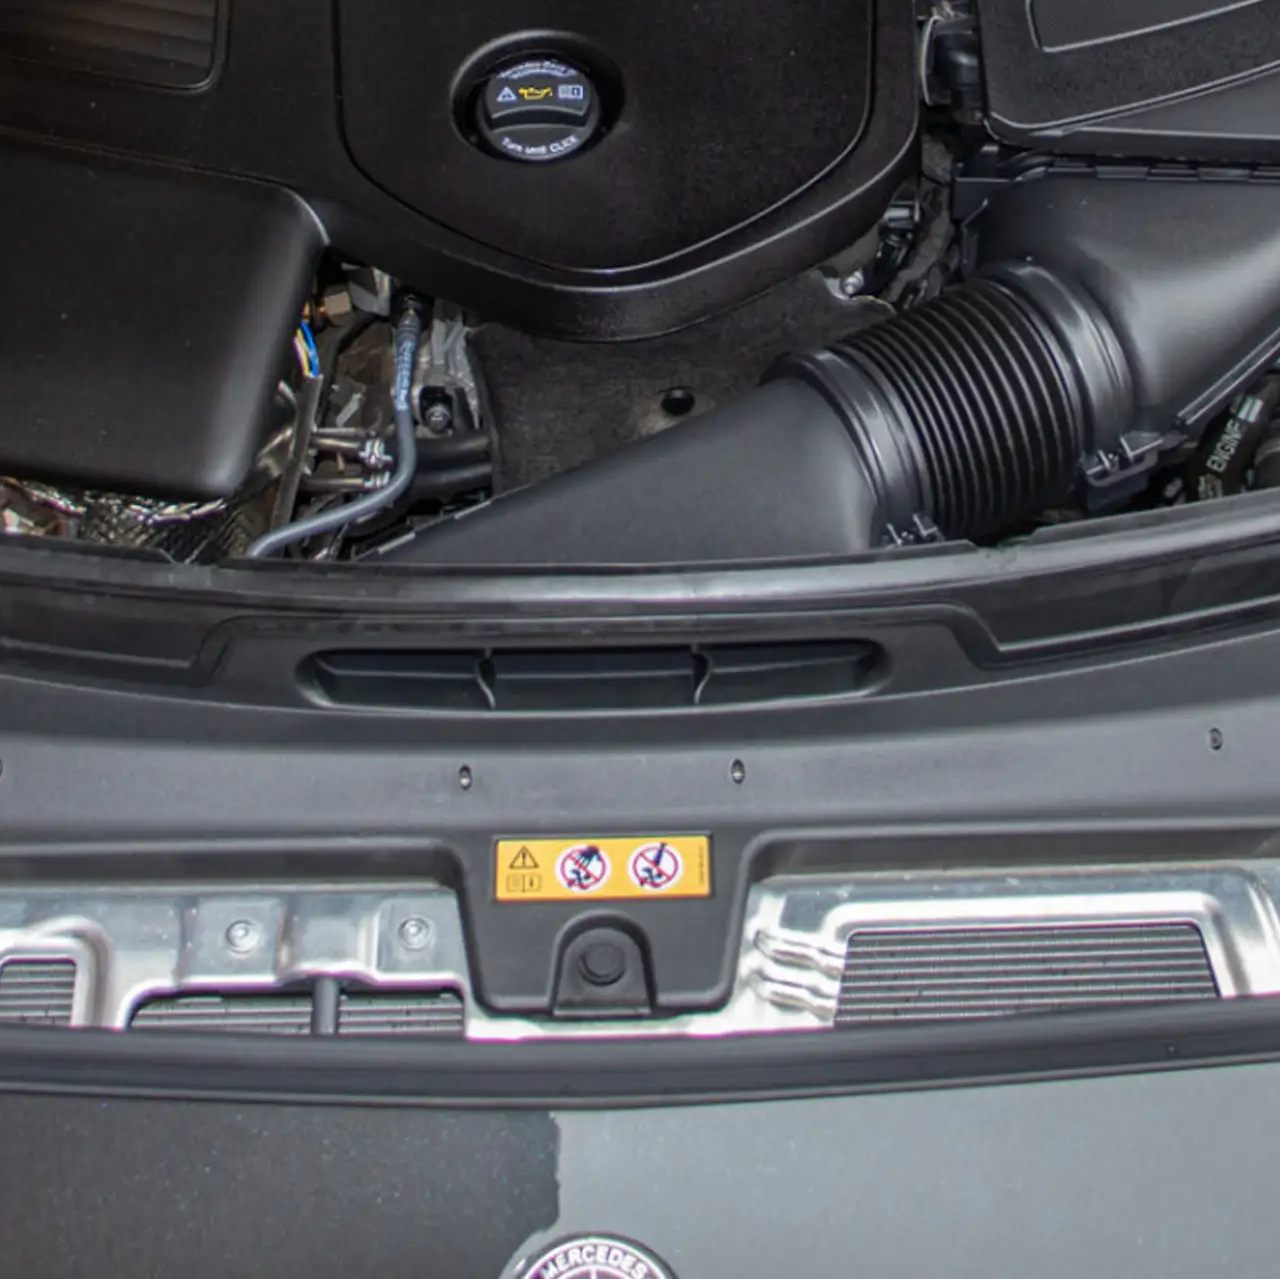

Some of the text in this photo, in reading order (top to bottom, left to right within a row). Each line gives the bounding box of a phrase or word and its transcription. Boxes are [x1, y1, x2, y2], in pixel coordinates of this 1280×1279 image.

[550, 135, 580, 152] CLICK
[1206, 419, 1241, 472] ENGINE
[542, 1246, 647, 1279] MERCEDES
